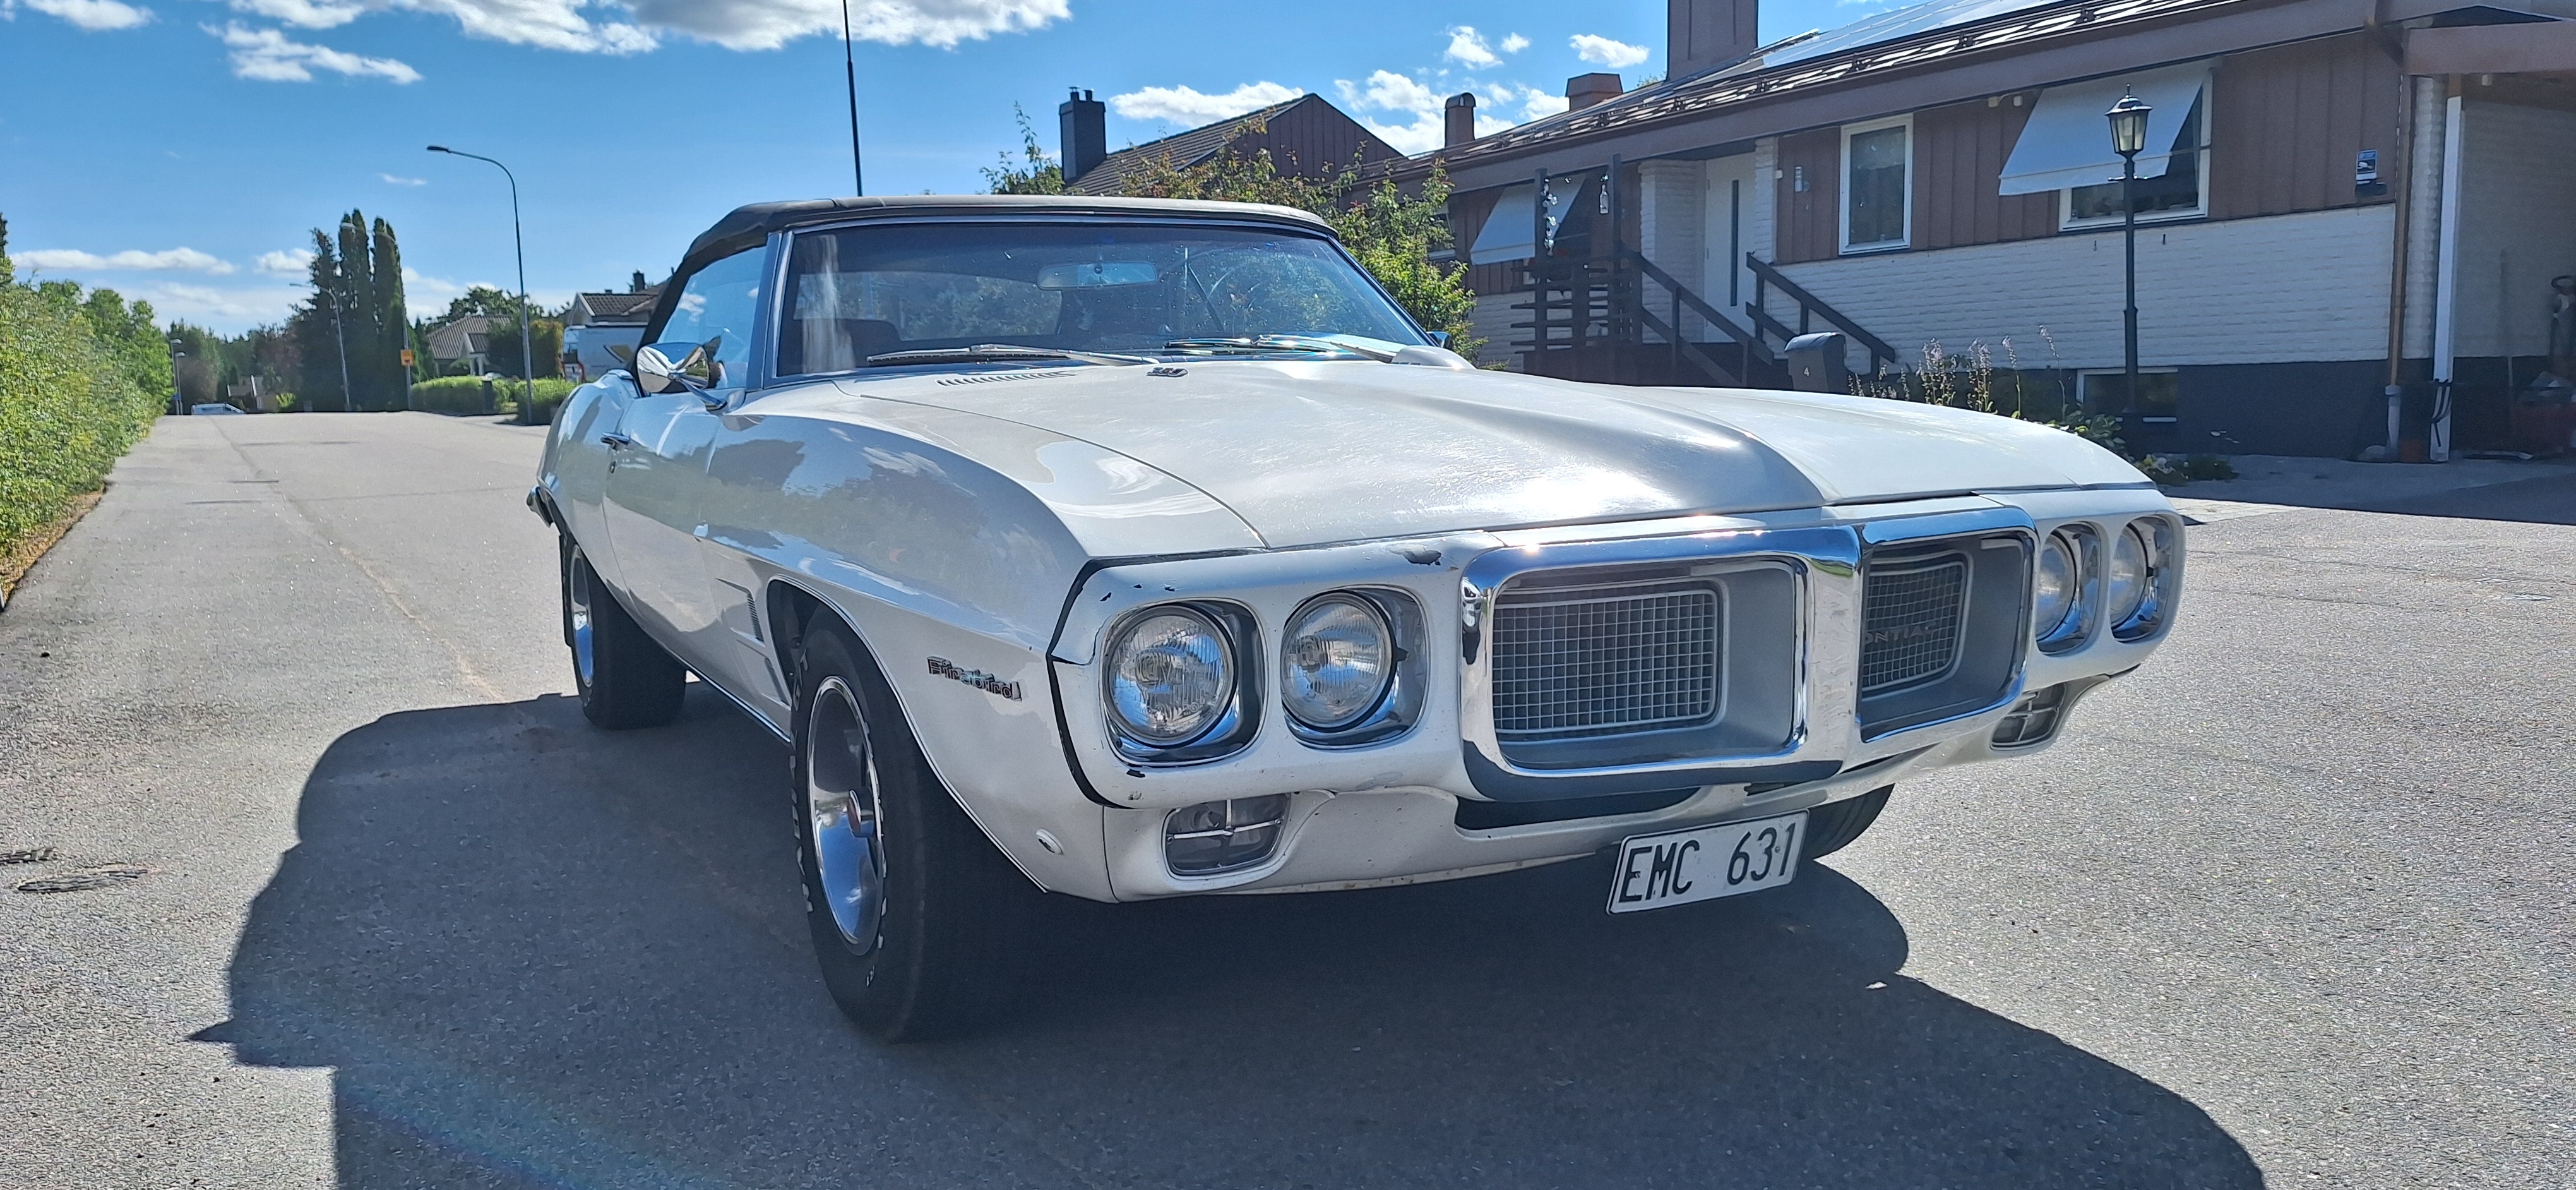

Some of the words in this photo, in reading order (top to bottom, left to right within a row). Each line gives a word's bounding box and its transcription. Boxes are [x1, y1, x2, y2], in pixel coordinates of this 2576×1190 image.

[1804, 367, 1810, 377] 4
[1864, 621, 1937, 645] ONTIAC
[926, 655, 1022, 702] Firebird
[1618, 839, 1700, 903] EMC
[1727, 822, 1796, 886] 631
